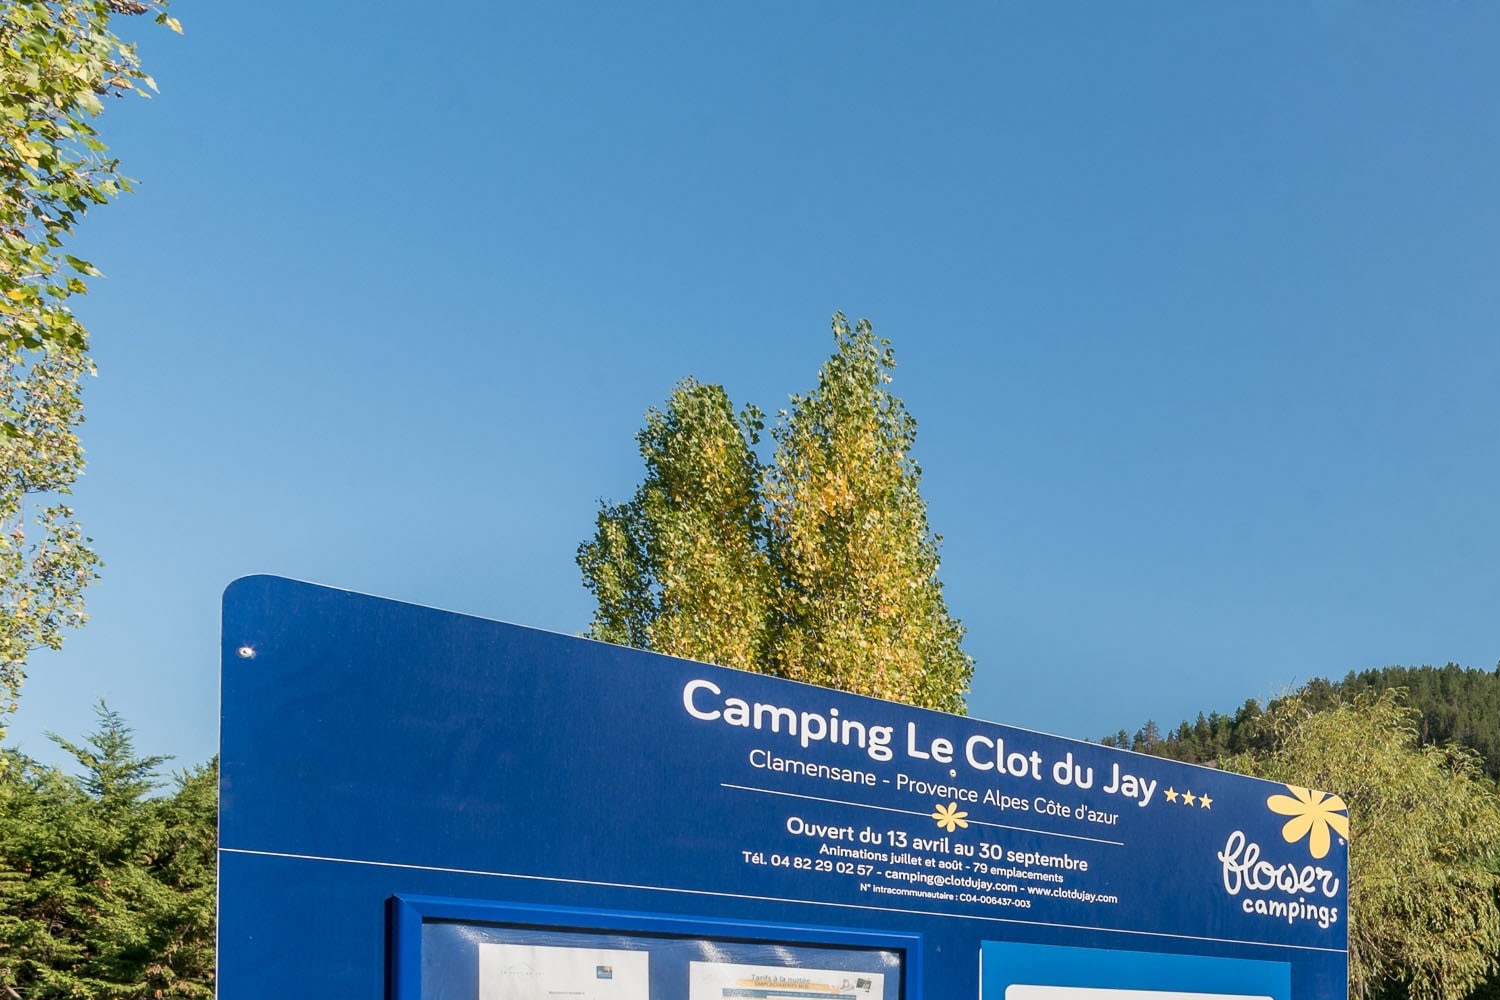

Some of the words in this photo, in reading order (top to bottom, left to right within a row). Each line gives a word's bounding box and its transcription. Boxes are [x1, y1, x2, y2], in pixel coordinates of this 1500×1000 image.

[682, 678, 894, 763] Camping
[907, 721, 954, 764] Le
[965, 734, 1043, 781] Clot
[1052, 751, 1094, 790] du
[1102, 762, 1158, 808] Jay
[749, 748, 877, 786] Clamensane
[896, 773, 979, 803] Provence
[982, 788, 1030, 811] Alpes
[1033, 797, 1071, 818] Côte
[1074, 803, 1119, 825] d'azur
[786, 816, 855, 842] Ouvert
[859, 826, 882, 845] du
[886, 830, 908, 848] 13
[912, 836, 950, 854] avril
[953, 843, 975, 857] au
[978, 842, 1003, 861] 30
[1006, 850, 1089, 872] septembre
[819, 843, 889, 862] Animations
[889, 852, 923, 867] juillet
[924, 857, 936, 868] et
[938, 859, 963, 871] août
[972, 861, 988, 874] 79
[989, 866, 1064, 883] emplacements
[1217, 830, 1340, 898] flower
[741, 850, 768, 865] Tél.
[770, 854, 791, 868] 04
[793, 856, 812, 870] 82
[814, 859, 833, 872] 29
[835, 861, 854, 875] 02
[856, 864, 874, 877] 57
[884, 868, 1018, 893] camping@clotdujay.com
[1026, 886, 1118, 904] www.clotdujay.com
[872, 884, 955, 901] intracommunautaire
[959, 893, 1031, 909] C04-006437-003
[1242, 896, 1338, 929] campings
